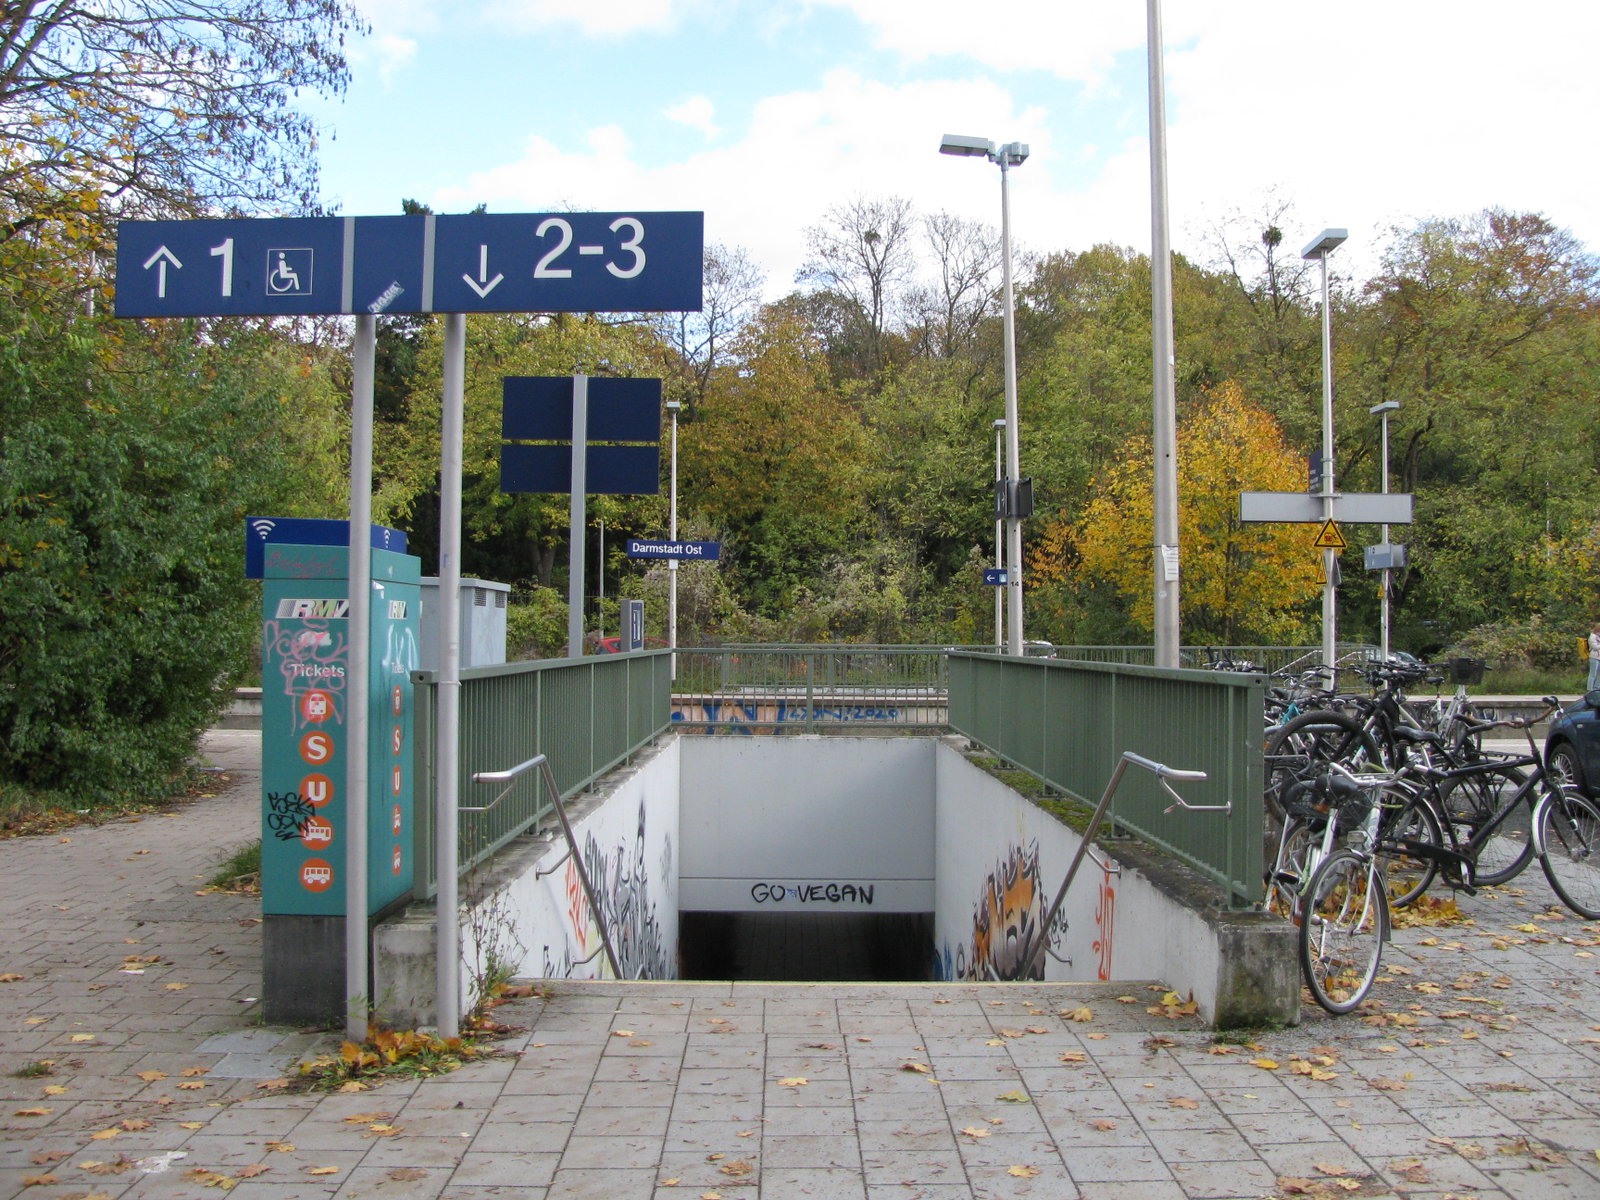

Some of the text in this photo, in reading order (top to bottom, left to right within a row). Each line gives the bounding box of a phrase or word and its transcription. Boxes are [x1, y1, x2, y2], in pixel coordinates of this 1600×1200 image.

[533, 217, 646, 279] 2-3
[210, 238, 234, 296] 1
[632, 542, 703, 555] Darmstadt Ost
[289, 599, 349, 618] RMV
[291, 663, 345, 677] Tickets
[307, 735, 327, 760] S
[394, 729, 400, 751] S
[308, 781, 327, 802] U
[394, 771, 400, 791] U
[751, 883, 786, 903] GO
[798, 883, 874, 905] VEGAN
